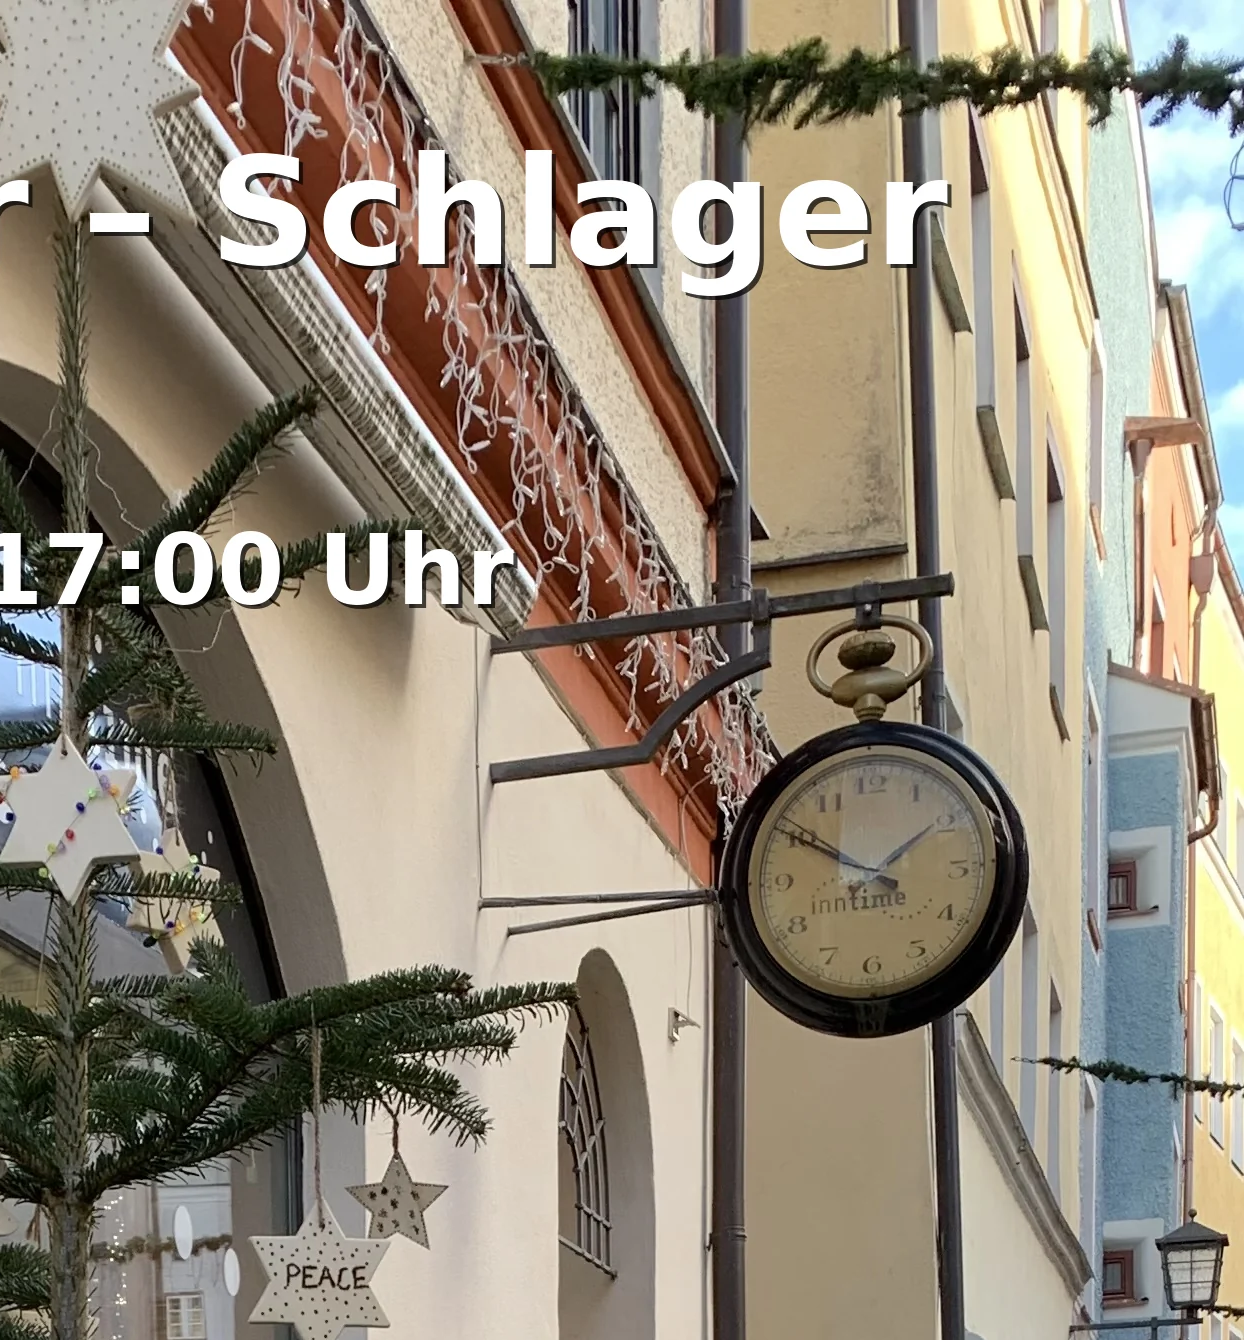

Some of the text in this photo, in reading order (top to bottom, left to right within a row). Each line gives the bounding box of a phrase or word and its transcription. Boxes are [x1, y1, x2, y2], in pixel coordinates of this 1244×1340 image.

[775, 873, 794, 892] 9
[811, 886, 906, 915] inntime
[937, 903, 954, 921] 4
[788, 915, 808, 934] 8
[819, 946, 839, 965] 7
[906, 939, 926, 958] 5
[862, 955, 882, 974] 6
[283, 1262, 370, 1290] PEACE
